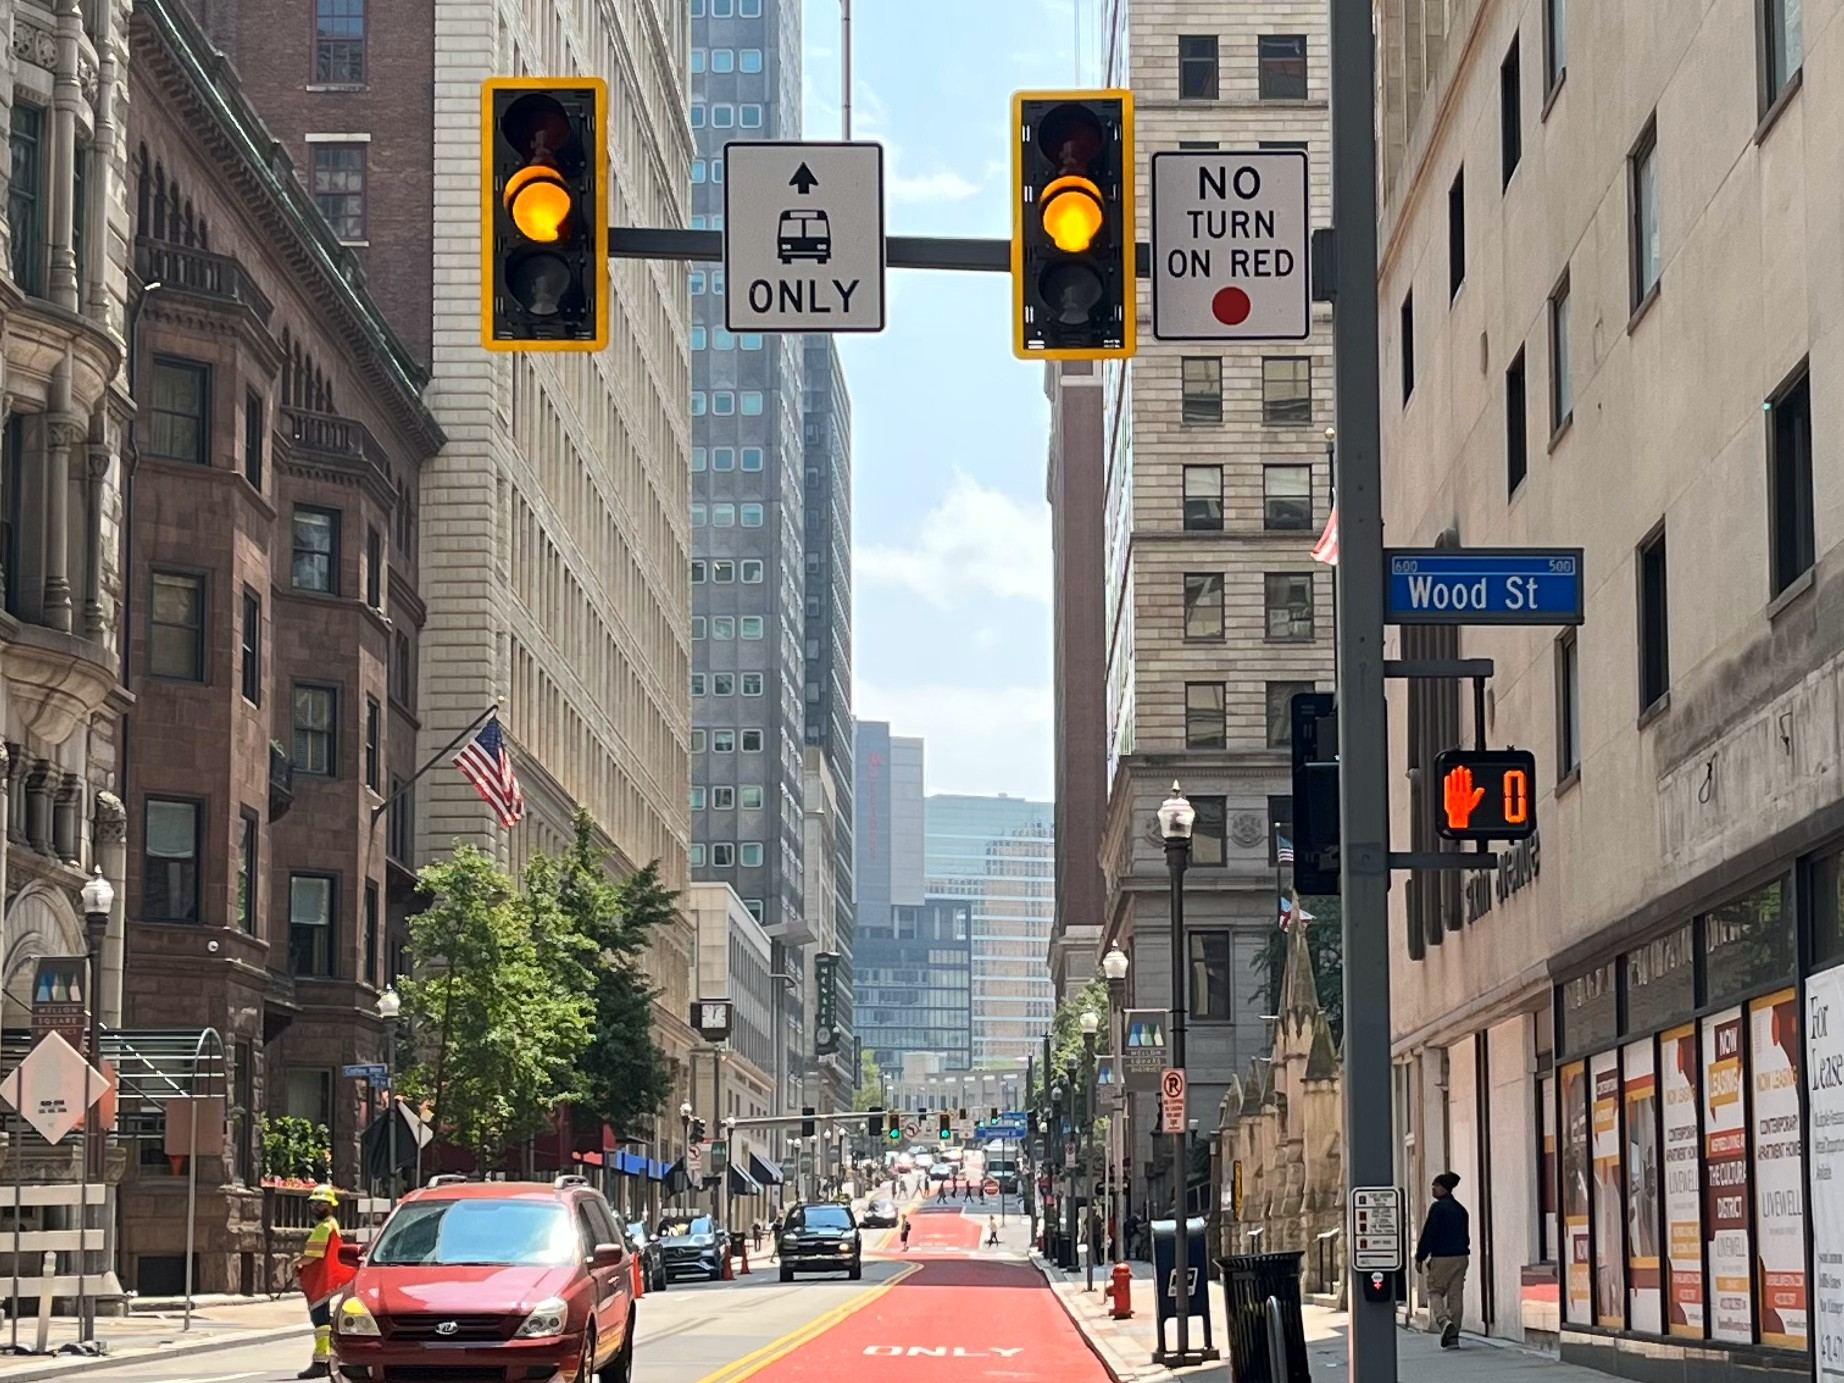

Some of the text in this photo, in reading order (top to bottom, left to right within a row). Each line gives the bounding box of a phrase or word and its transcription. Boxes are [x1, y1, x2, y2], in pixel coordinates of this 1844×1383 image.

[1199, 166, 1260, 200] NO
[1187, 210, 1274, 239] TURN
[1168, 249, 1294, 278] ON RED
[749, 279, 860, 314] ONLY
[1394, 559, 1572, 573] 600 500
[1408, 575, 1539, 609] Wood St
[1503, 770, 1527, 823] 0
[1809, 995, 1829, 1040] For
[1719, 1027, 1738, 1056] NOW
[1710, 1066, 1739, 1096] LEASING
[1812, 1047, 1843, 1091] Lease
[1708, 1165, 1720, 1186] THE
[1717, 1196, 1743, 1219] DISTRICT
[1762, 1190, 1803, 1218] LIVEWELL
[862, 1345, 1025, 1357] ONLY
